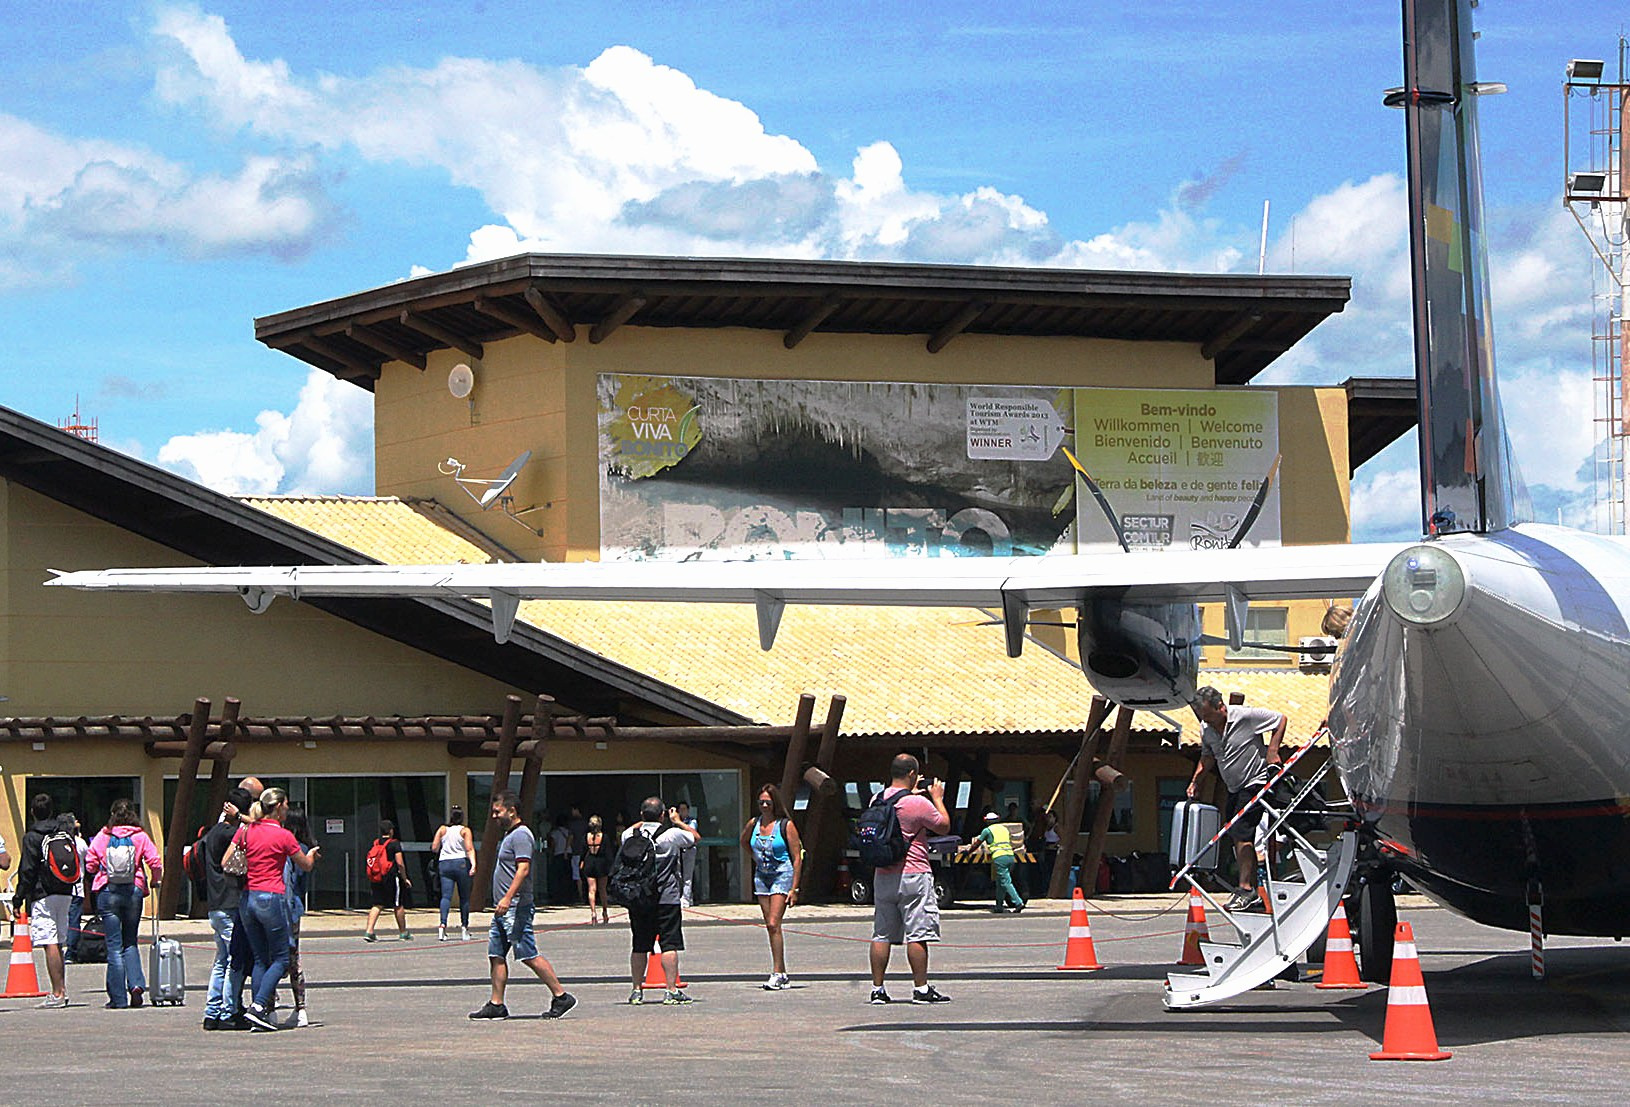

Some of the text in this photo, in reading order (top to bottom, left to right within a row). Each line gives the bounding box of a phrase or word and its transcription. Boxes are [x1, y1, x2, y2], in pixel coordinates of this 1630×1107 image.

[627, 406, 676, 422] CURTA
[995, 403, 1038, 412] Responsible
[1141, 403, 1216, 416] Bem-vindo
[632, 422, 672, 440] VIVA
[1094, 419, 1263, 434] Willkommen Welcome
[621, 440, 688, 457] BONITO
[970, 438, 1012, 448] WINNER
[1095, 435, 1263, 449] Bienvenido Benvenuto
[1127, 451, 1177, 465] Accueil
[1124, 478, 1137, 489] da
[1140, 479, 1177, 490] beleza
[1181, 482, 1188, 490] e
[1191, 479, 1204, 490] de
[1207, 481, 1238, 492] gente
[1174, 494, 1199, 503] beauty
[1214, 495, 1237, 504] happy
[1124, 517, 1169, 529] SECTUR
